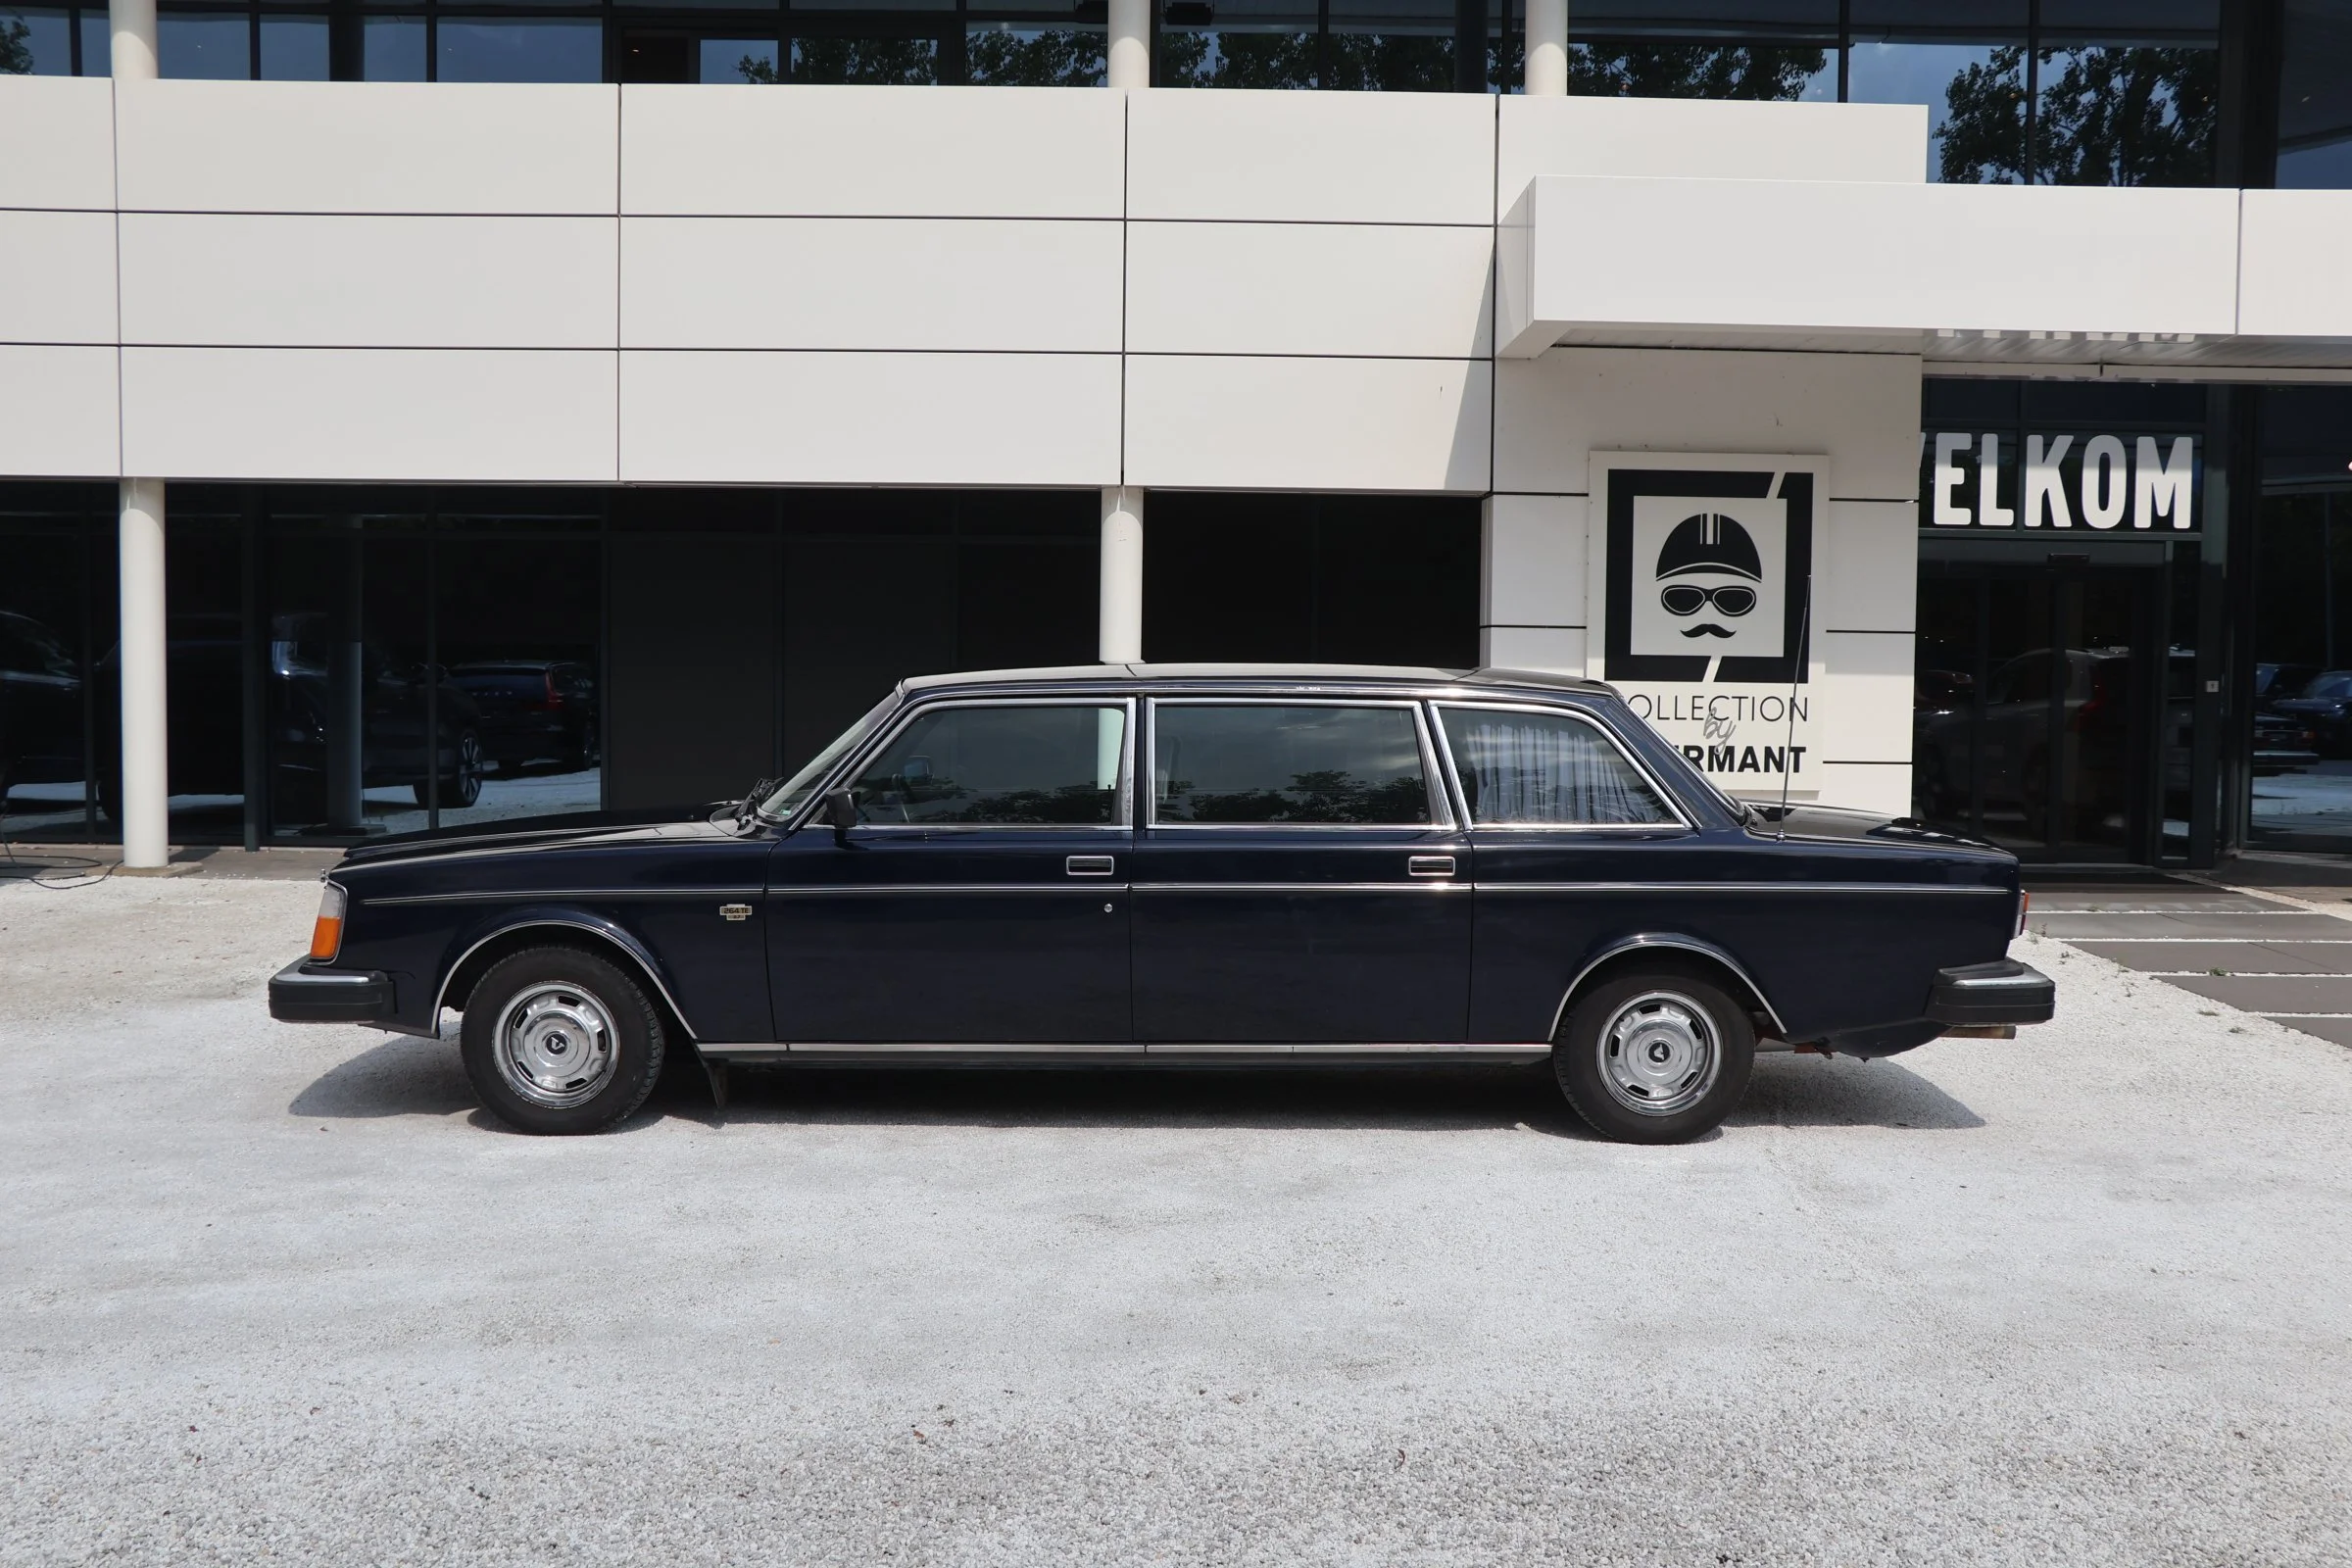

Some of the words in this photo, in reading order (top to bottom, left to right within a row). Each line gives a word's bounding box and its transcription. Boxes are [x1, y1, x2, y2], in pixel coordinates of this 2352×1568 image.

[1920, 432, 2193, 529] ELKOM
[1627, 694, 1808, 722] OLLECTION
[1703, 706, 1737, 756] by
[1674, 745, 1807, 773] RMANT
